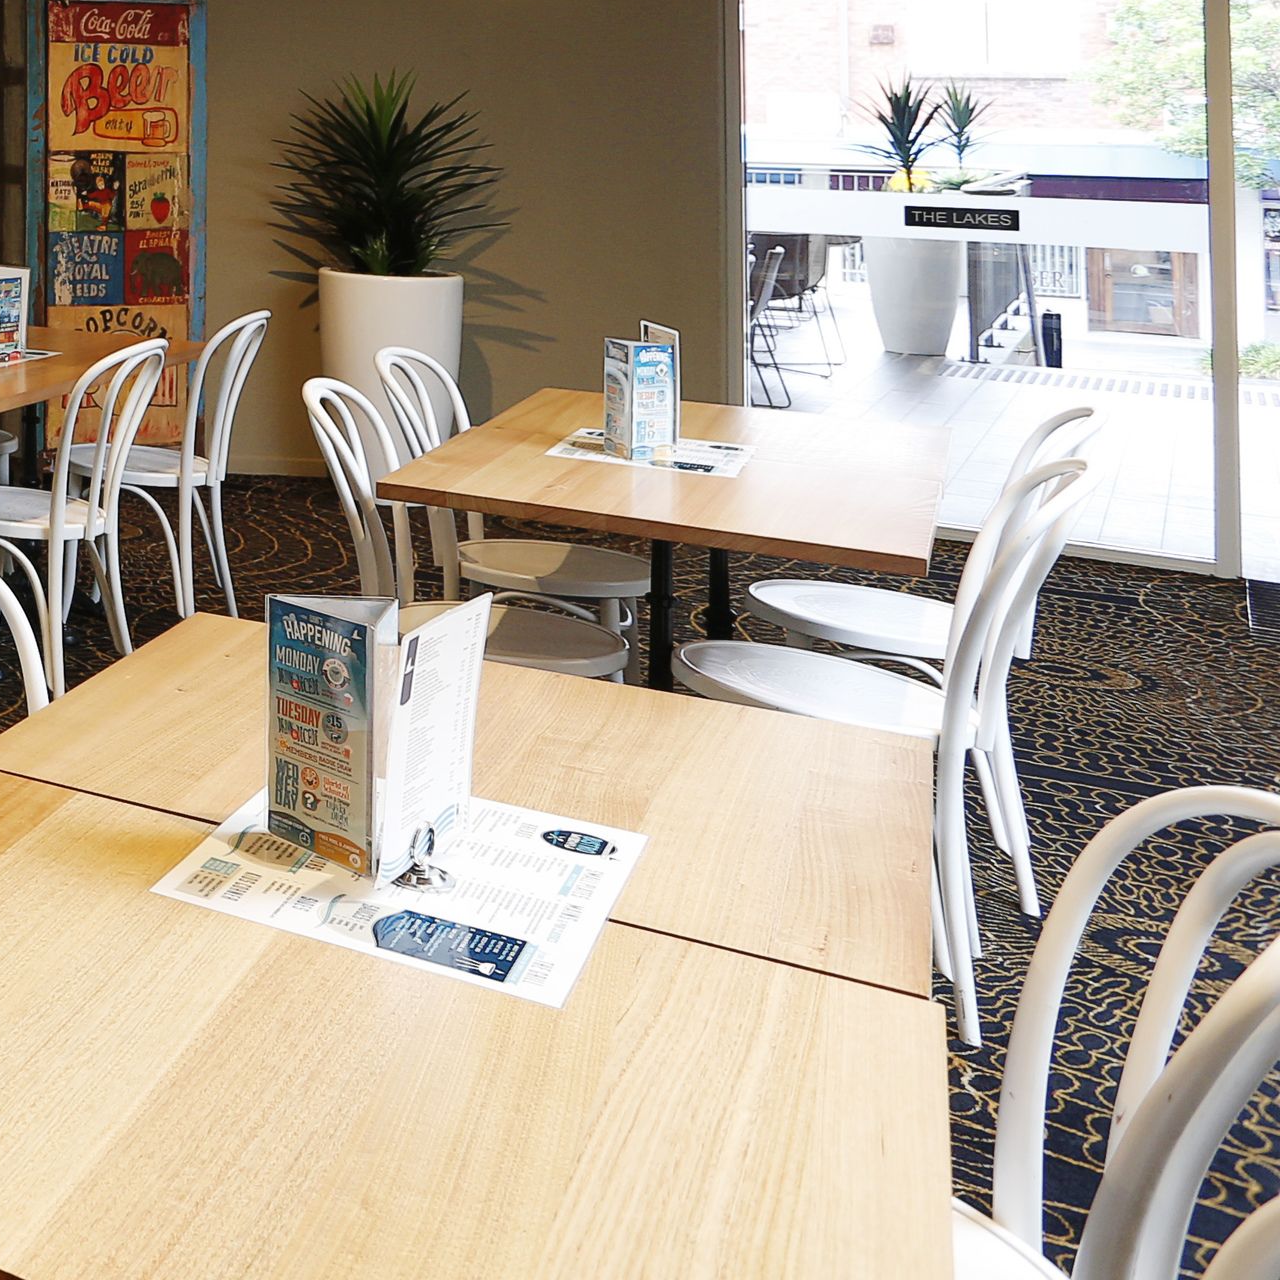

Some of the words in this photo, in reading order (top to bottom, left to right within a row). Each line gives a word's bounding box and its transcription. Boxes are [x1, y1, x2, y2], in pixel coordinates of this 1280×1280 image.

[73, 43, 101, 62] ICE
[107, 45, 154, 64] COLD
[61, 63, 178, 136] Beer
[911, 210, 948, 223] THE
[952, 212, 1012, 226] LAKES
[61, 234, 119, 256] EATRE
[75, 307, 173, 340] OPCOR
[283, 619, 351, 656] HAPPENING
[275, 644, 320, 675] MONDAY
[275, 696, 320, 729] TUESDAY
[303, 791, 314, 810] ?
[219, 880, 253, 902] CORNER
